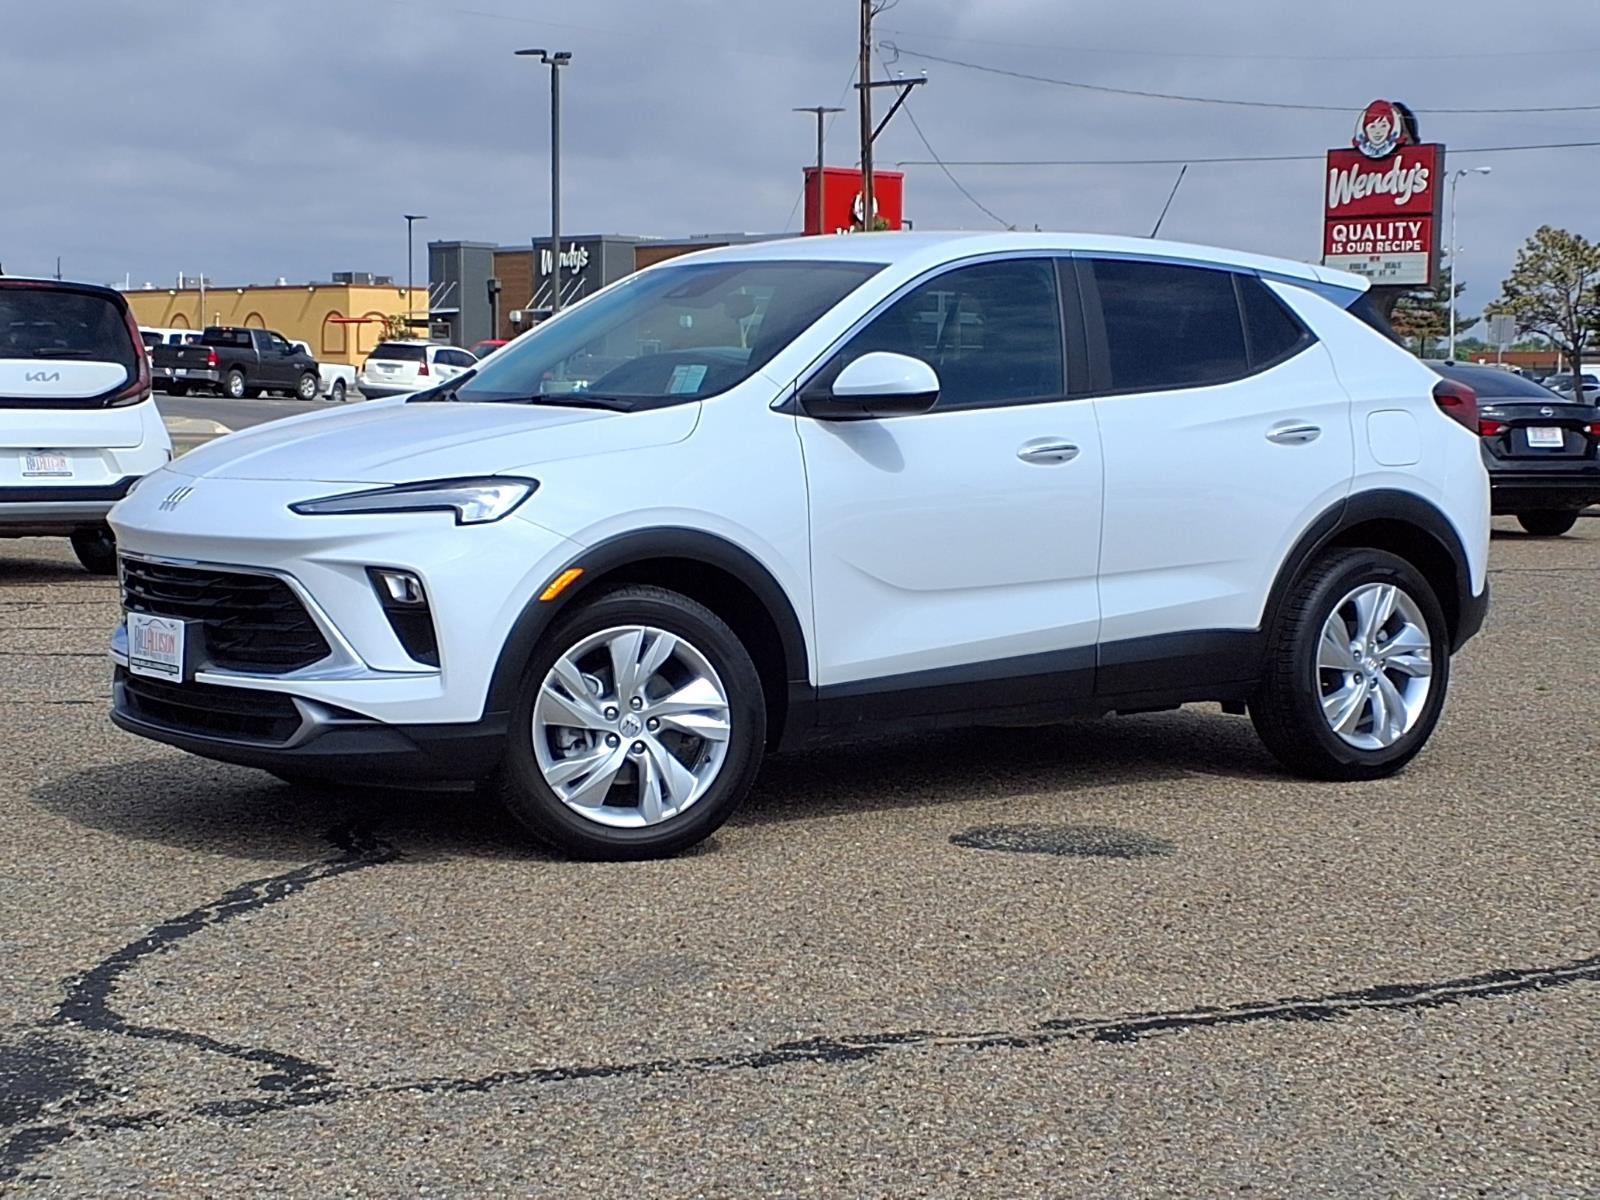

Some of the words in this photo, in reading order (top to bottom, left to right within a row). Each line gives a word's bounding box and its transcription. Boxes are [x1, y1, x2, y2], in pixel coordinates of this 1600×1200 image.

[1329, 155, 1429, 208] Wendy's
[1332, 221, 1422, 242] QUALITY
[541, 242, 589, 276] Wndy's
[1332, 243, 1343, 253] IS
[1346, 241, 1373, 253] OUR
[1376, 240, 1422, 252] RECIPE
